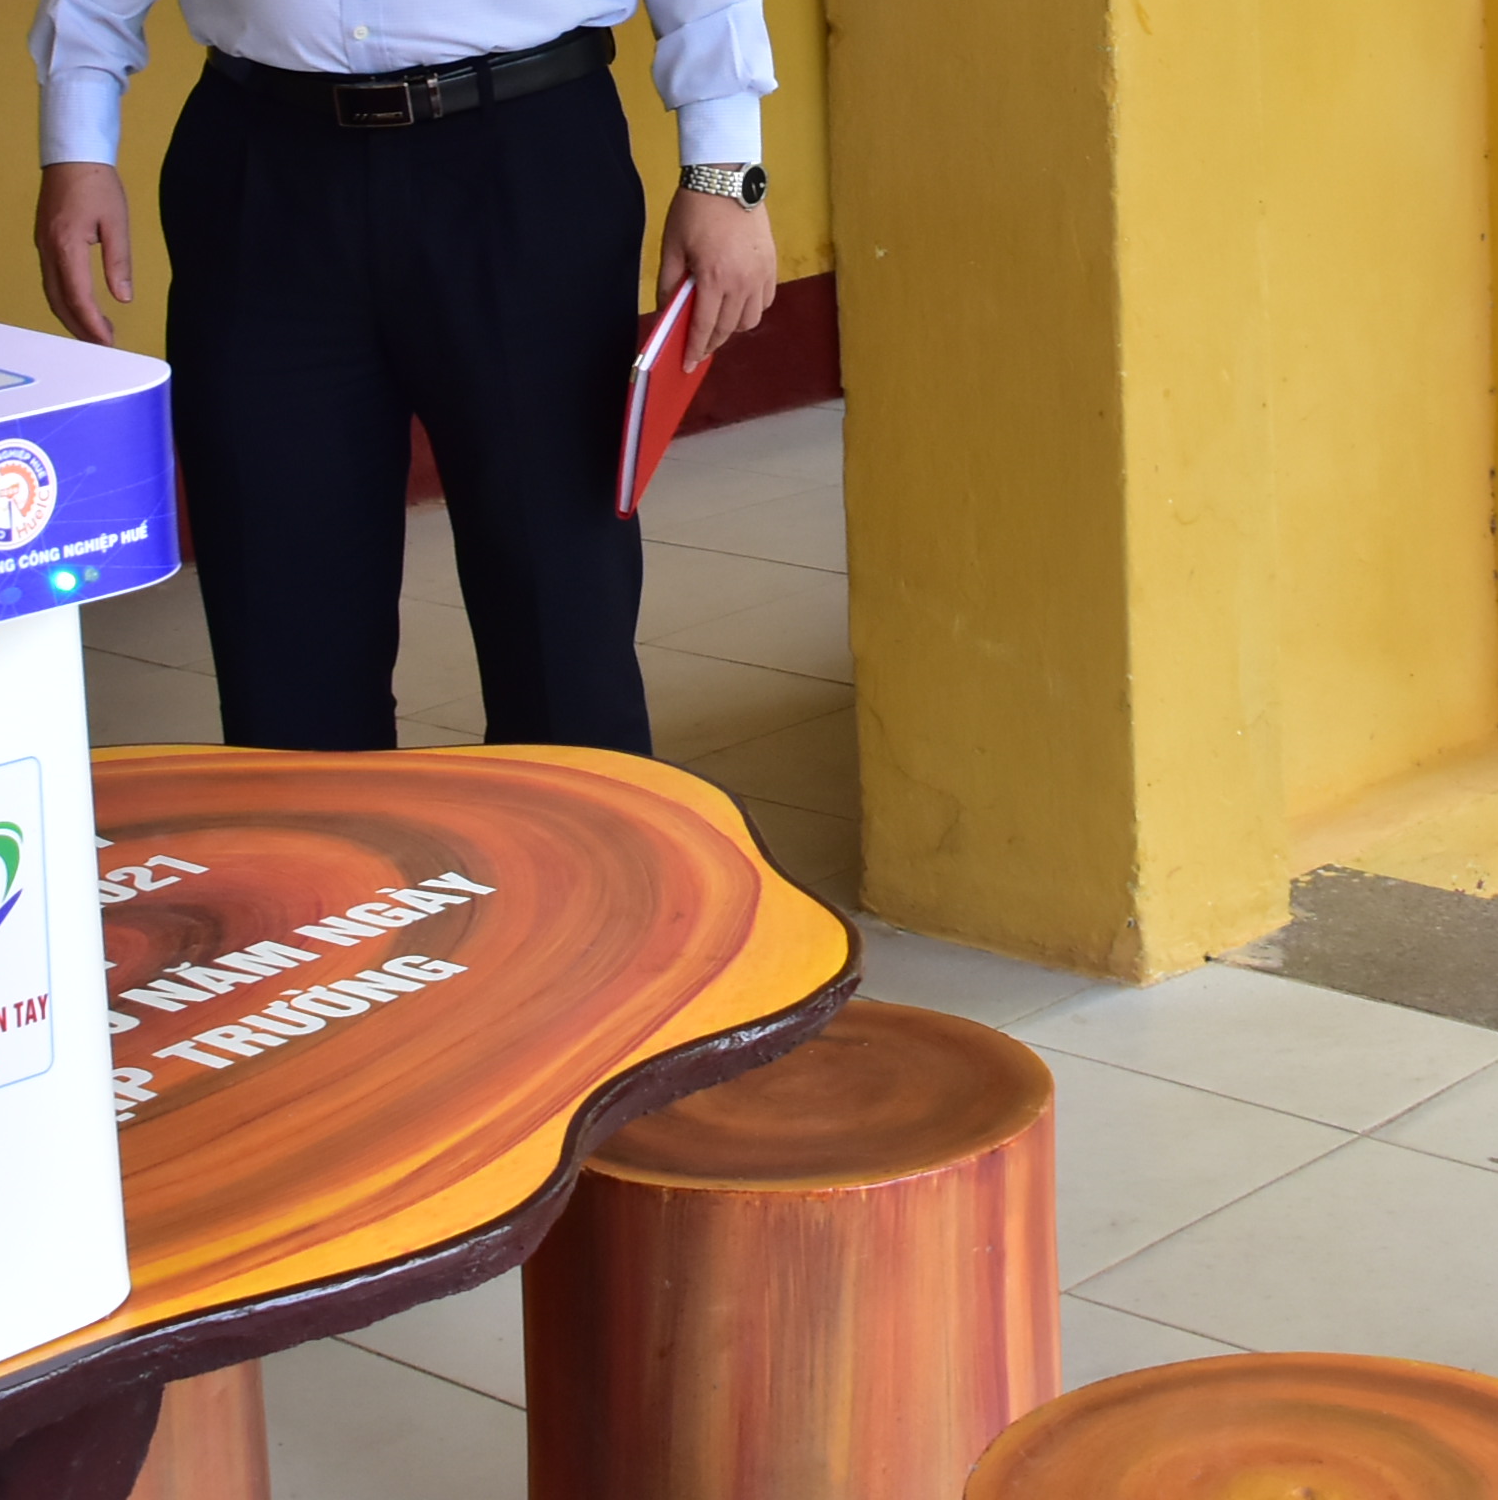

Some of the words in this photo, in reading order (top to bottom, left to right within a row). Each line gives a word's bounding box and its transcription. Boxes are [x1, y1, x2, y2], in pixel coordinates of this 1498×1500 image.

[18, 547, 61, 569] CÔNG
[63, 532, 118, 558] NGHIỆP
[121, 519, 149, 543] HUẾ
[118, 940, 321, 1012] NĂM
[294, 871, 497, 946] NGÀY
[13, 993, 49, 1029] TAY
[152, 954, 468, 1069] TRƯỜNG
